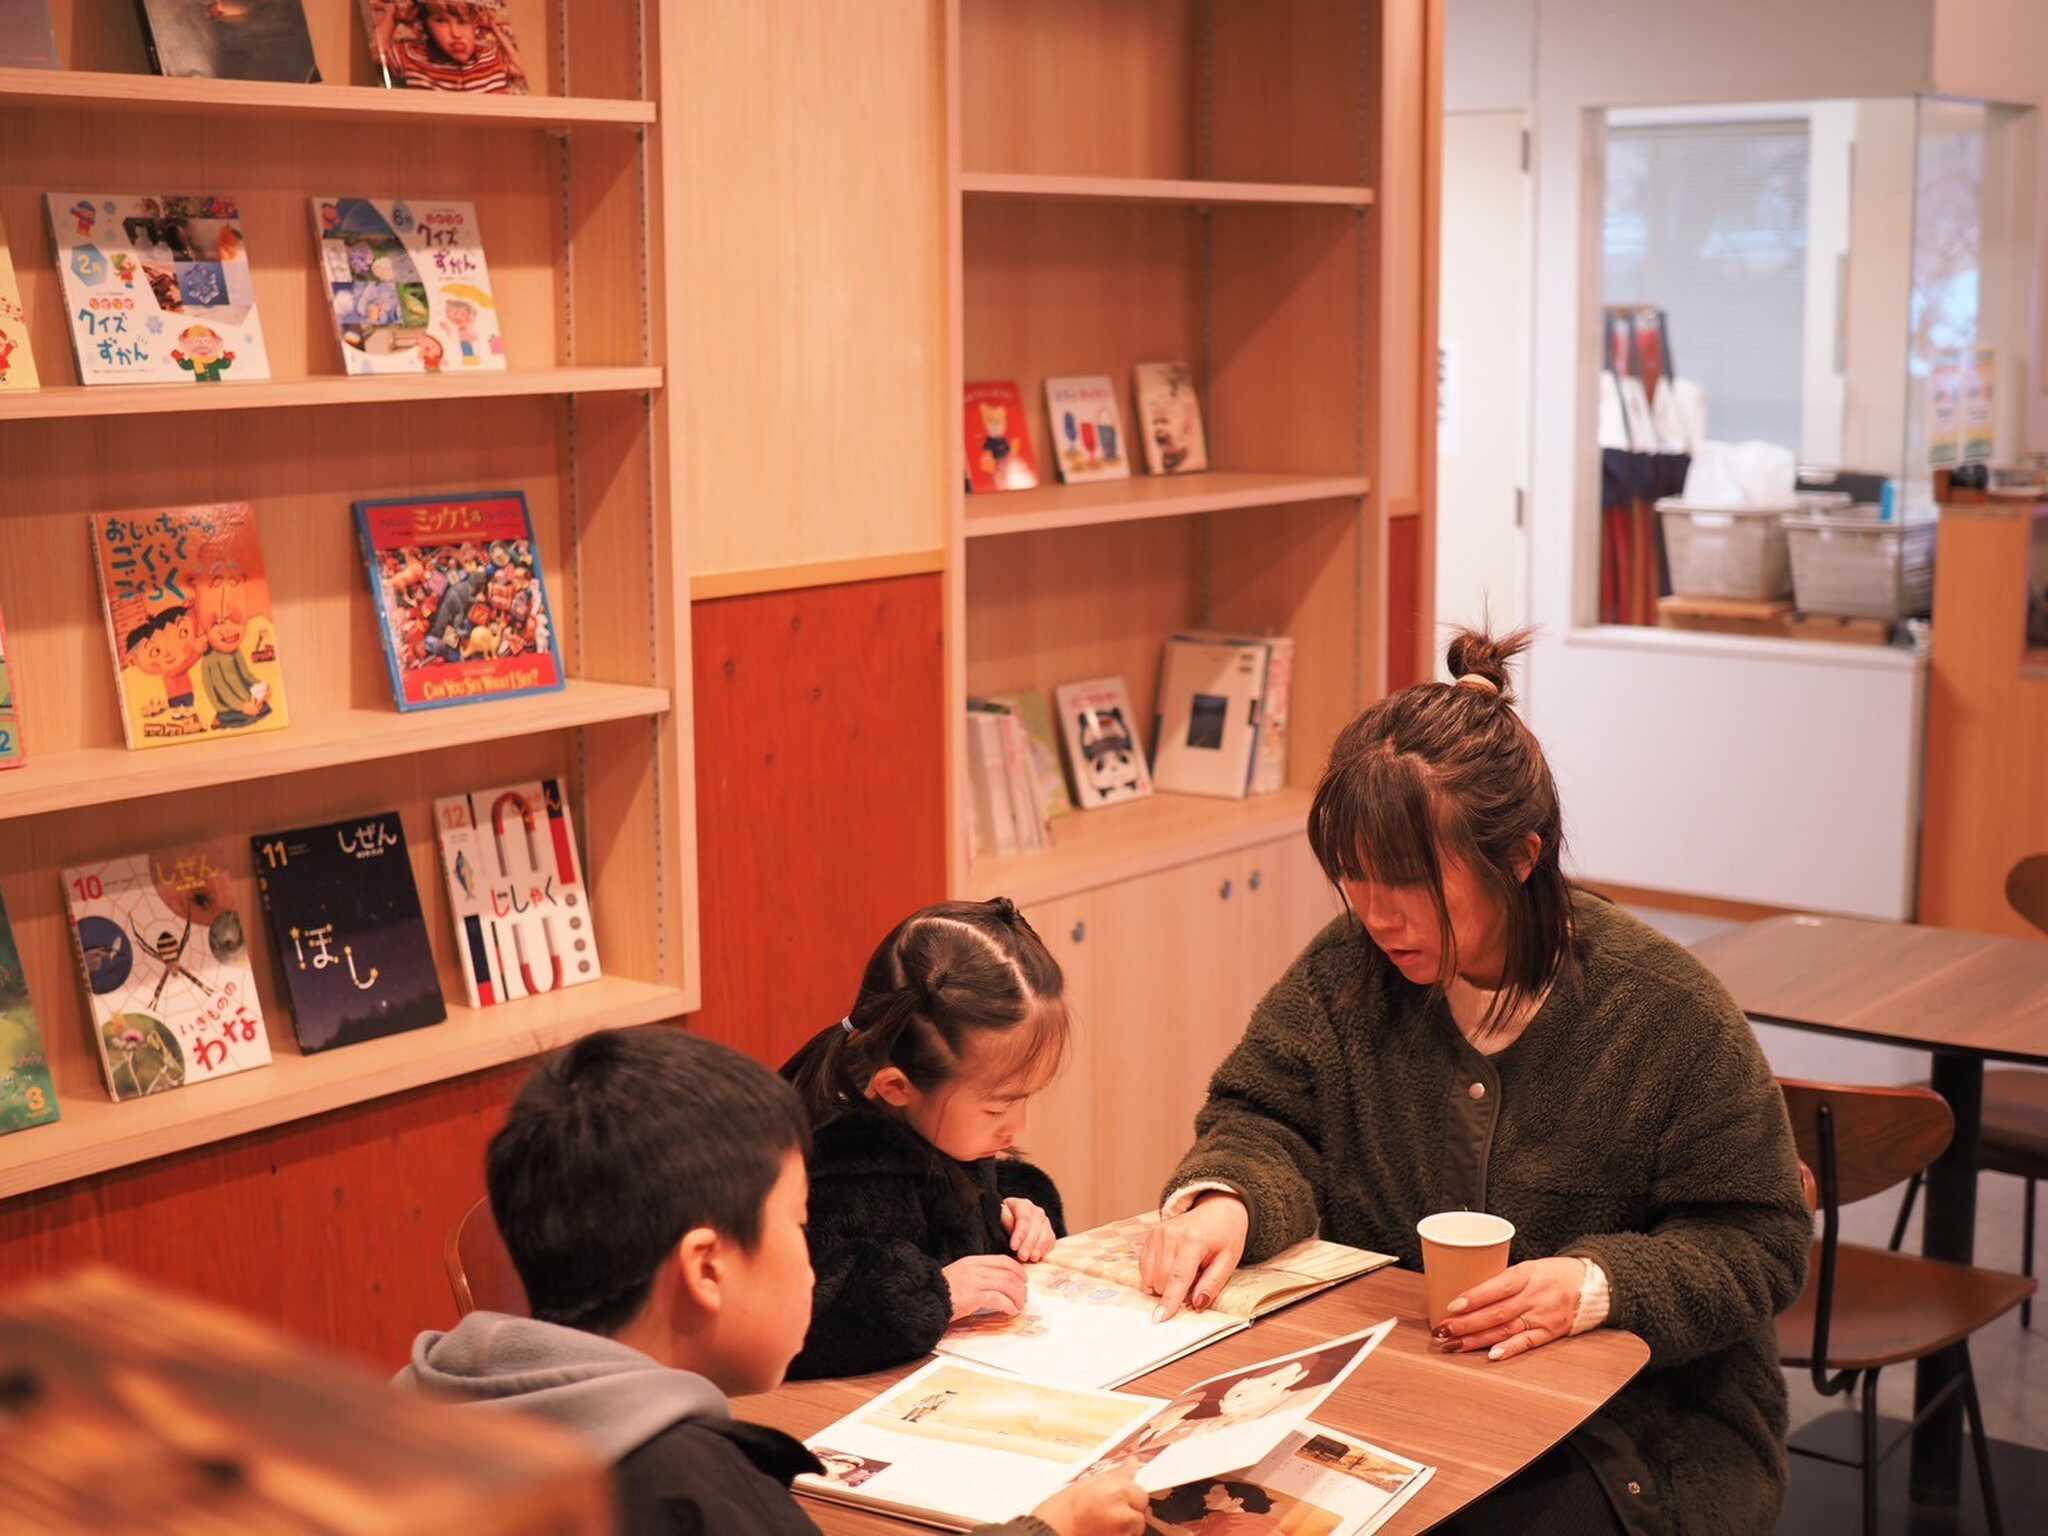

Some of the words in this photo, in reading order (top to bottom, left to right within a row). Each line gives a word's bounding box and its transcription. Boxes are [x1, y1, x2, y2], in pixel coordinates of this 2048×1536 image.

[417, 223, 459, 247] クイズ
[433, 248, 476, 274] ずかん
[79, 308, 127, 335] クイズ
[97, 337, 149, 365] ずかん
[112, 537, 187, 572] ごくらく
[114, 568, 186, 600] ごくらく
[442, 805, 466, 829] 12
[338, 822, 397, 853] しぜん
[263, 841, 288, 868] 11
[156, 855, 220, 885] しぜん
[73, 875, 104, 902] 10
[491, 875, 557, 917] じしゃく
[289, 923, 379, 989] ほし
[180, 982, 236, 1035] いきものの
[193, 1007, 256, 1071] わな
